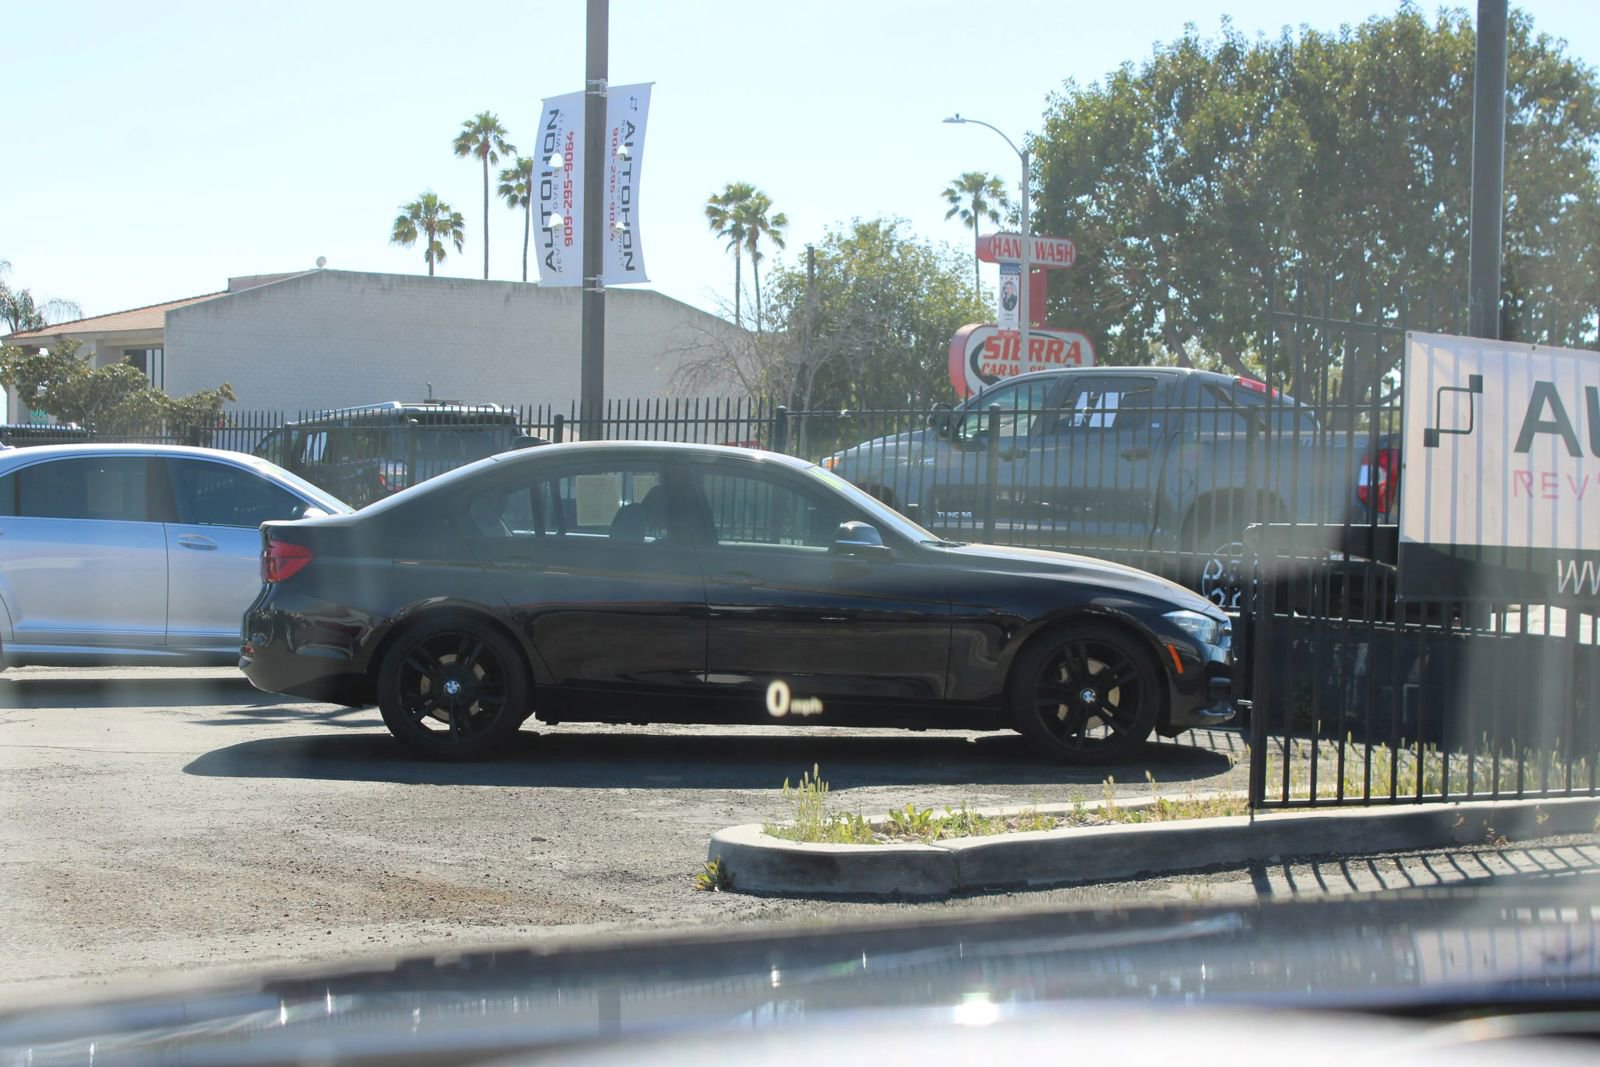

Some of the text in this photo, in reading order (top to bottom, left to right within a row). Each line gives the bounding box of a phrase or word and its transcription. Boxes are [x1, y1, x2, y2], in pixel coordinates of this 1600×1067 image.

[540, 108, 560, 273] AUTOHON
[563, 131, 574, 248] 909-295-9064
[621, 119, 636, 271] AUTOHON
[993, 237, 1073, 262] HAN WASH
[981, 363, 1008, 376] CAR
[766, 679, 791, 718] 0
